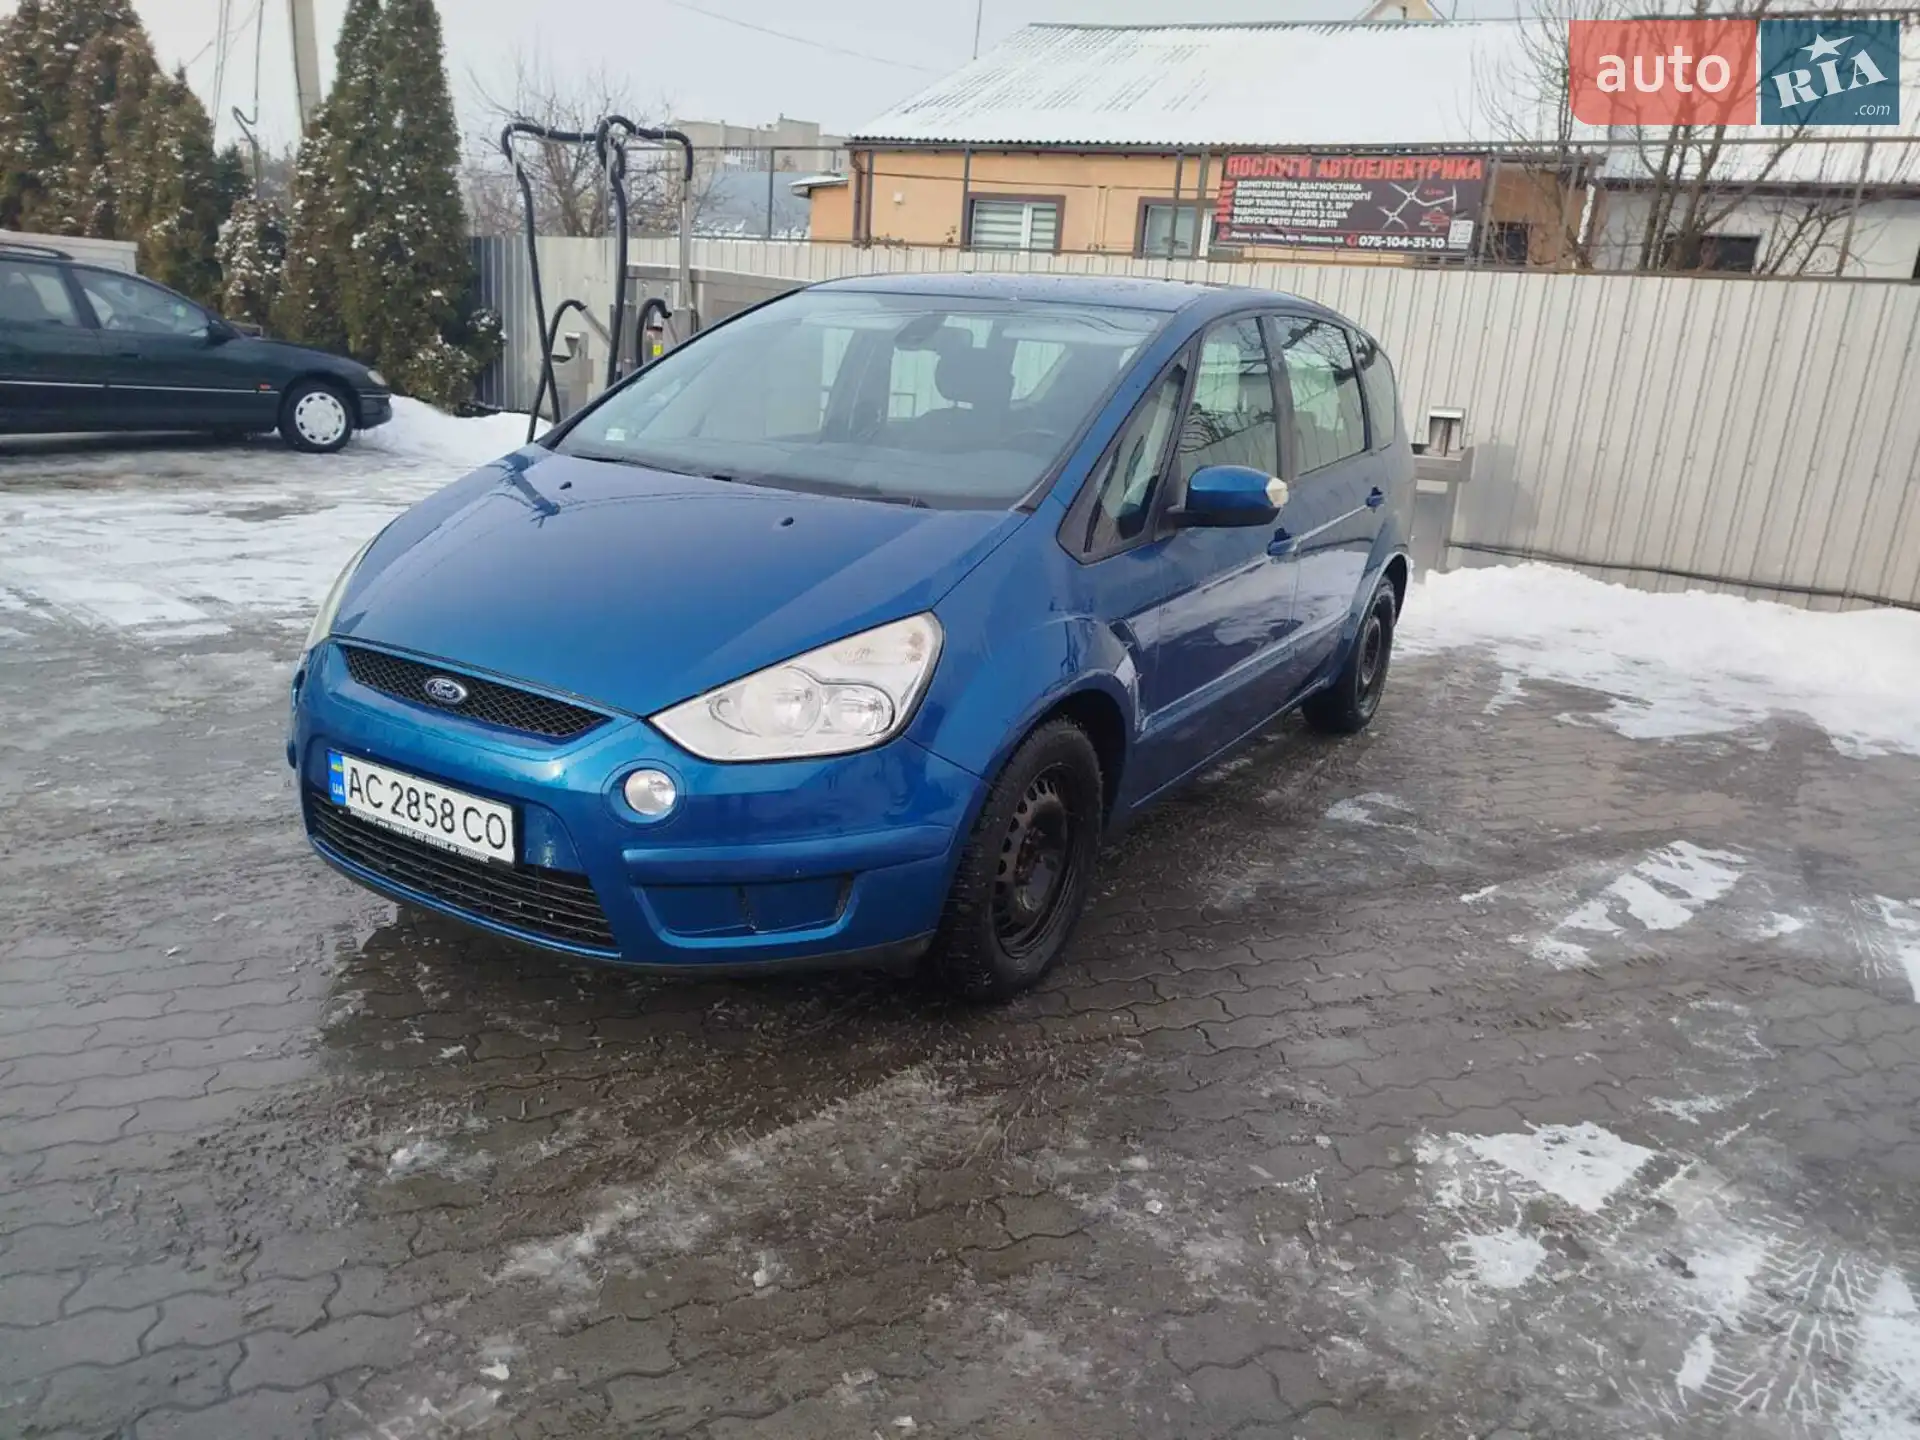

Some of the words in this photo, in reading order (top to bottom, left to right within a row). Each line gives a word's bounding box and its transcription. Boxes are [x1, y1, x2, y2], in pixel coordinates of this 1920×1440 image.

[1227, 155, 1313, 178] ПОСЛУГИ
[1316, 157, 1482, 180] АВТОЕЛЕКТРИКА
[1358, 234, 1445, 248] 075-104-31-10
[431, 681, 457, 699] Ford
[332, 783, 344, 796] UA
[349, 767, 383, 809] AC
[389, 781, 456, 834] 2858
[462, 806, 507, 850] CO
